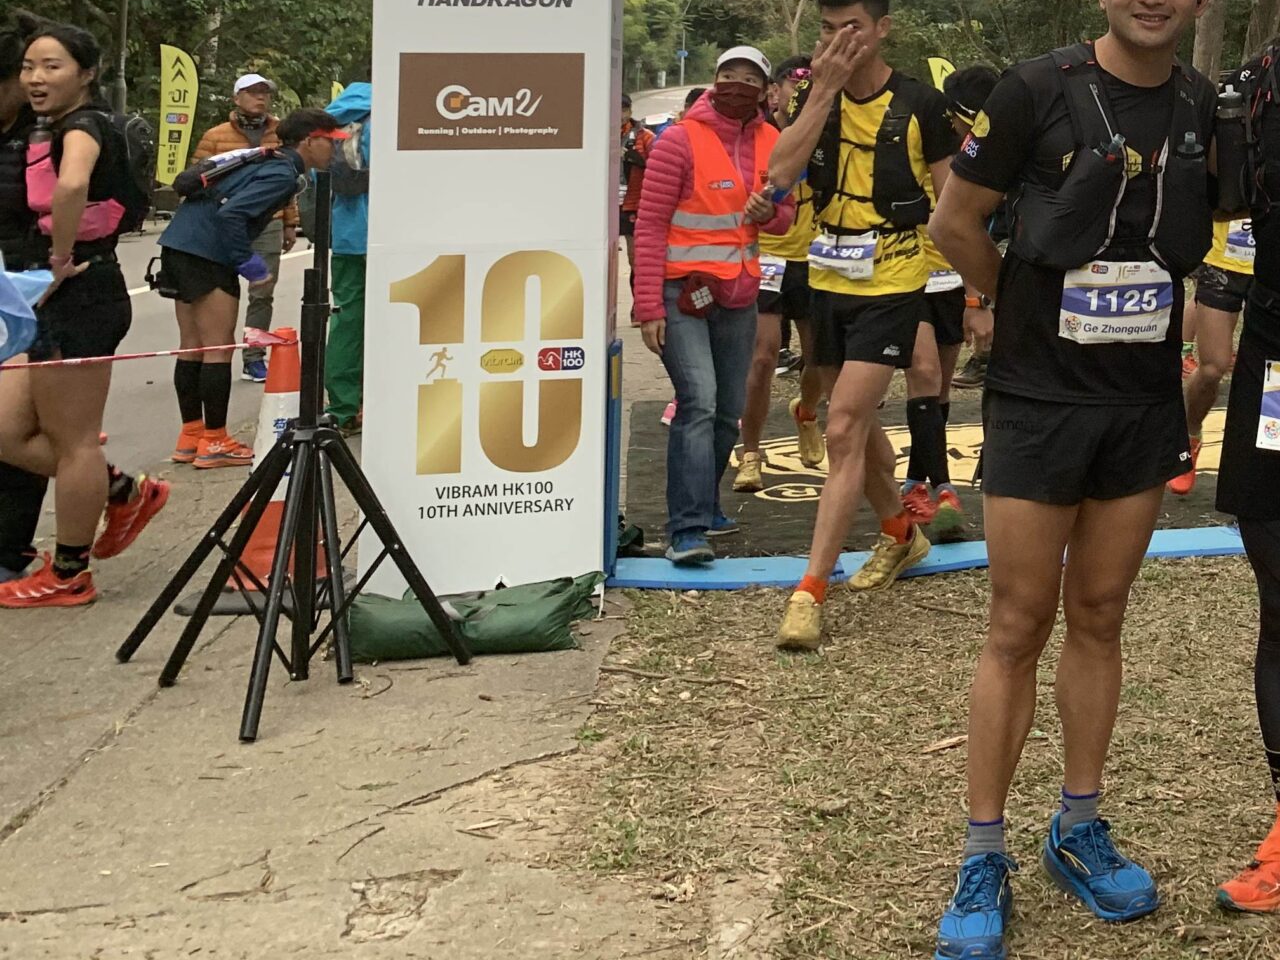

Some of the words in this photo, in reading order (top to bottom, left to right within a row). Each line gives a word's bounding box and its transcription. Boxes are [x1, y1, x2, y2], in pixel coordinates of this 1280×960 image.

[418, 127, 453, 136] Running
[461, 127, 496, 135] Outdoor
[504, 127, 558, 136] Photography
[1086, 288, 1158, 312] 1125
[1083, 323, 1099, 333] Ge
[1101, 323, 1157, 335] Zhongquan
[564, 349, 582, 359] HK
[389, 249, 584, 476] 10
[563, 358, 583, 368] 100
[435, 483, 498, 500] VIBRAM
[502, 480, 554, 497] HK100
[417, 504, 458, 520] 10TH
[463, 497, 574, 518] ANNIVERSARY
